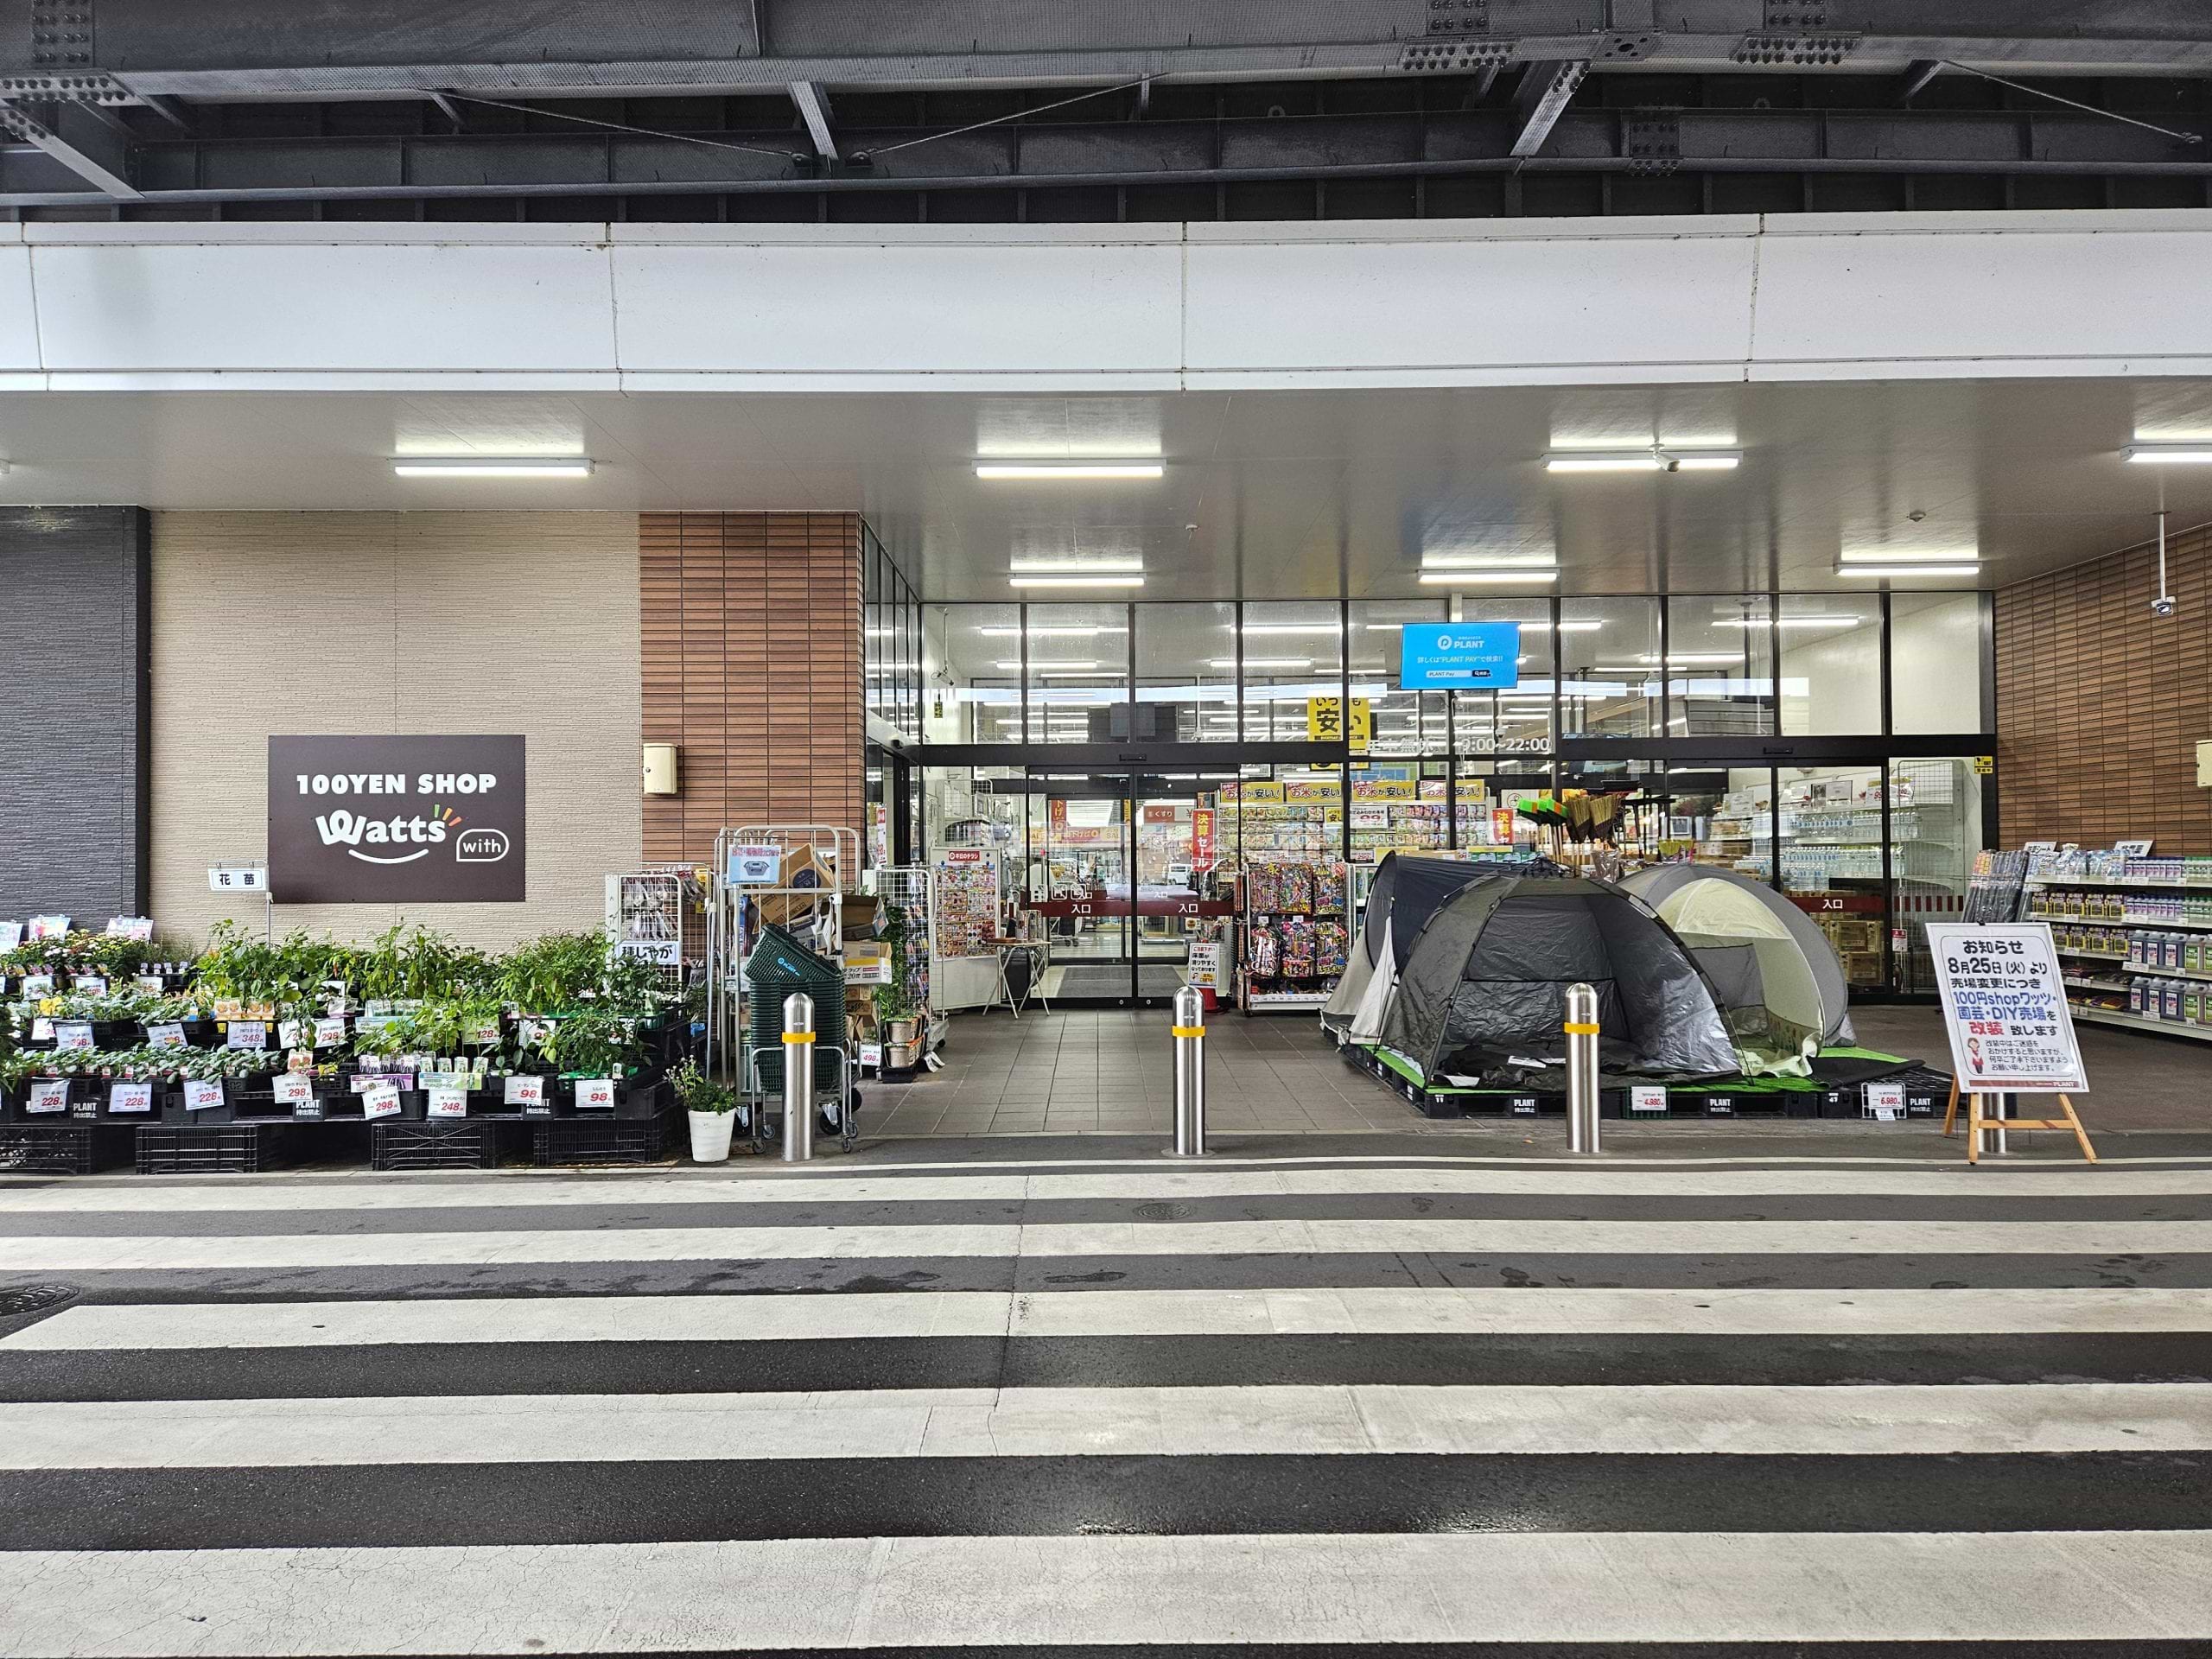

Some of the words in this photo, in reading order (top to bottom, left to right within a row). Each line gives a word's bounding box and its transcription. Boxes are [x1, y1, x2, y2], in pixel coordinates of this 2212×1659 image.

[1453, 640, 1484, 649] PLANT
[296, 774, 406, 794] 100YEN
[416, 773, 497, 795] SHOP
[315, 809, 447, 846] Watts
[462, 837, 501, 854] with
[1197, 813, 1209, 868] 決算セール
[1071, 904, 1092, 914] 入口
[1178, 903, 1198, 913] 入口
[1822, 899, 1844, 910] 入口
[1962, 940, 2024, 955] お知らせ
[1950, 977, 2041, 989] 売場変更につき
[1968, 1021, 2005, 1036] 改装
[2010, 1025, 2059, 1036] 致します
[296, 1099, 320, 1109] PLANT
[1514, 1098, 1535, 1107] PLANT
[1709, 1098, 1732, 1107] PLANT
[1910, 1097, 1931, 1106] PLANT
[73, 1103, 97, 1111] PLANT
